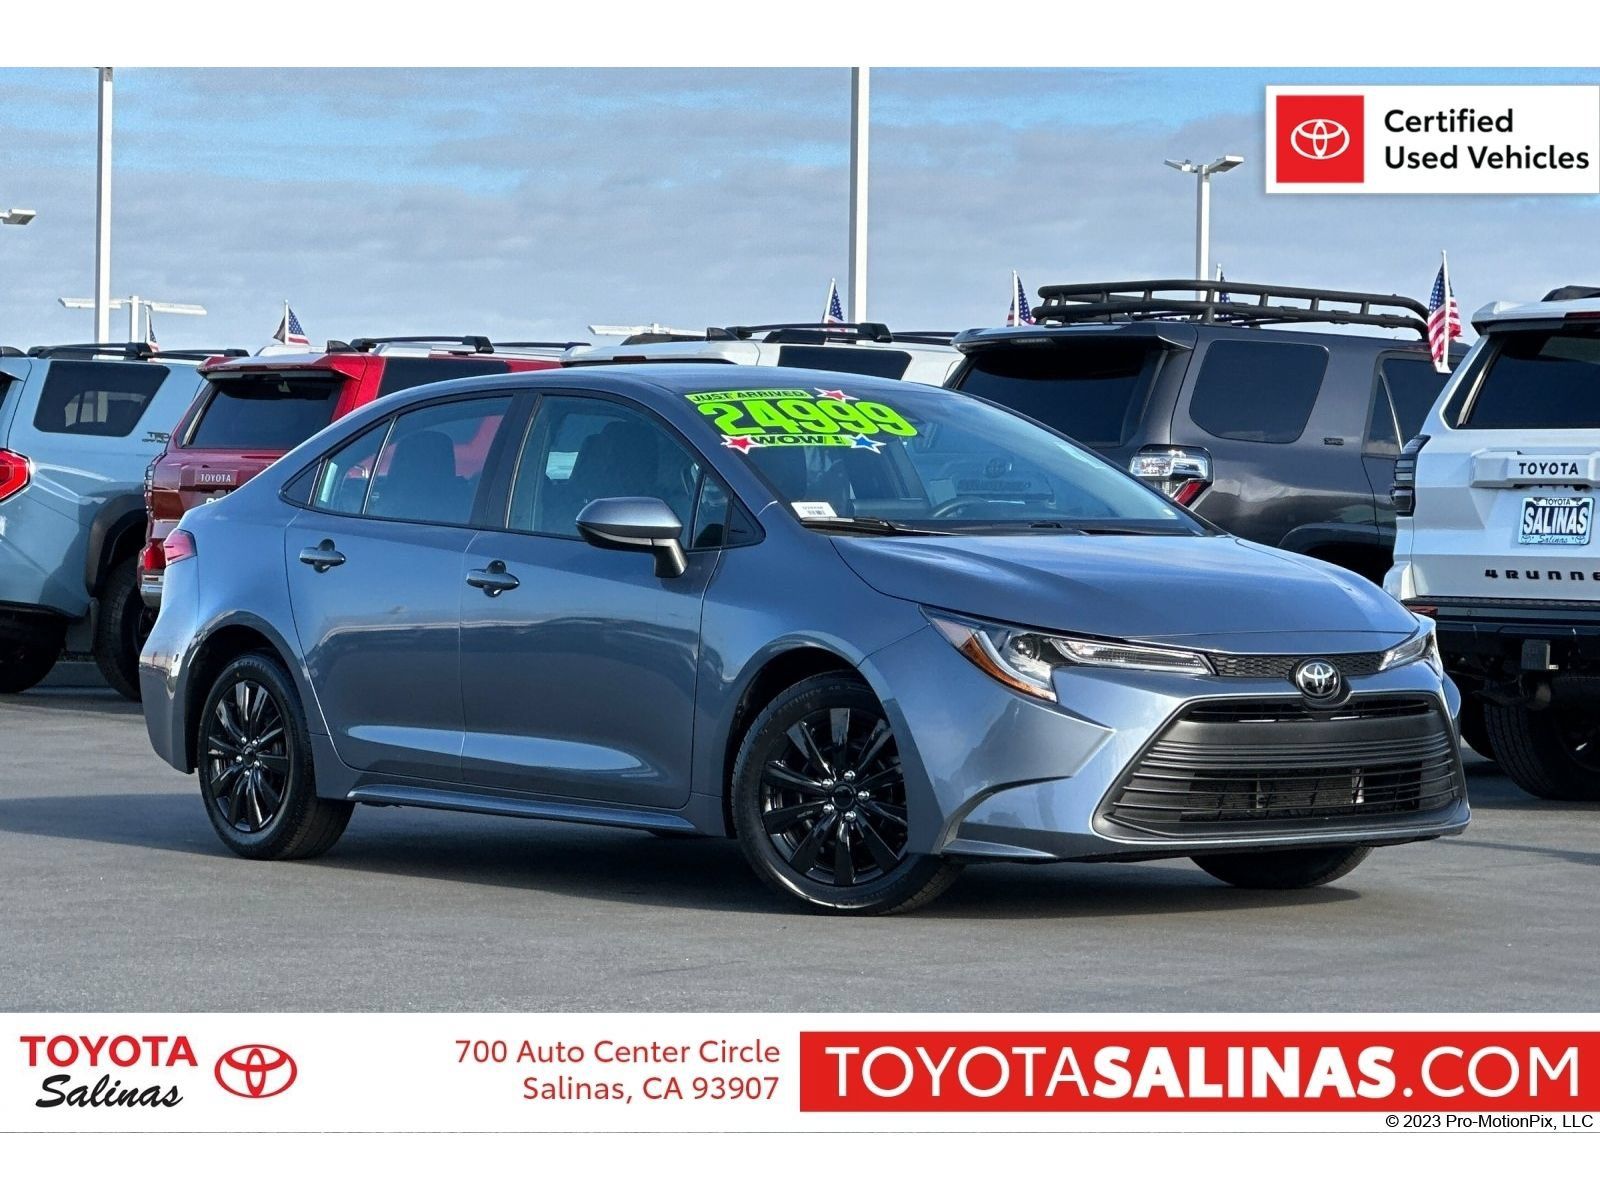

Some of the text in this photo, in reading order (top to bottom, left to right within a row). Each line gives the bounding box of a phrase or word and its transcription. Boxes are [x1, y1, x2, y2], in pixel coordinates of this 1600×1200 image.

[692, 389, 806, 402] JUST ARRIVED
[698, 399, 917, 436] 24999
[751, 435, 824, 444] WOW
[1519, 462, 1579, 475] TOYOTA
[200, 473, 231, 483] TOYOTA
[1545, 498, 1571, 506] TOYOTA
[1523, 506, 1588, 534] SALINAS
